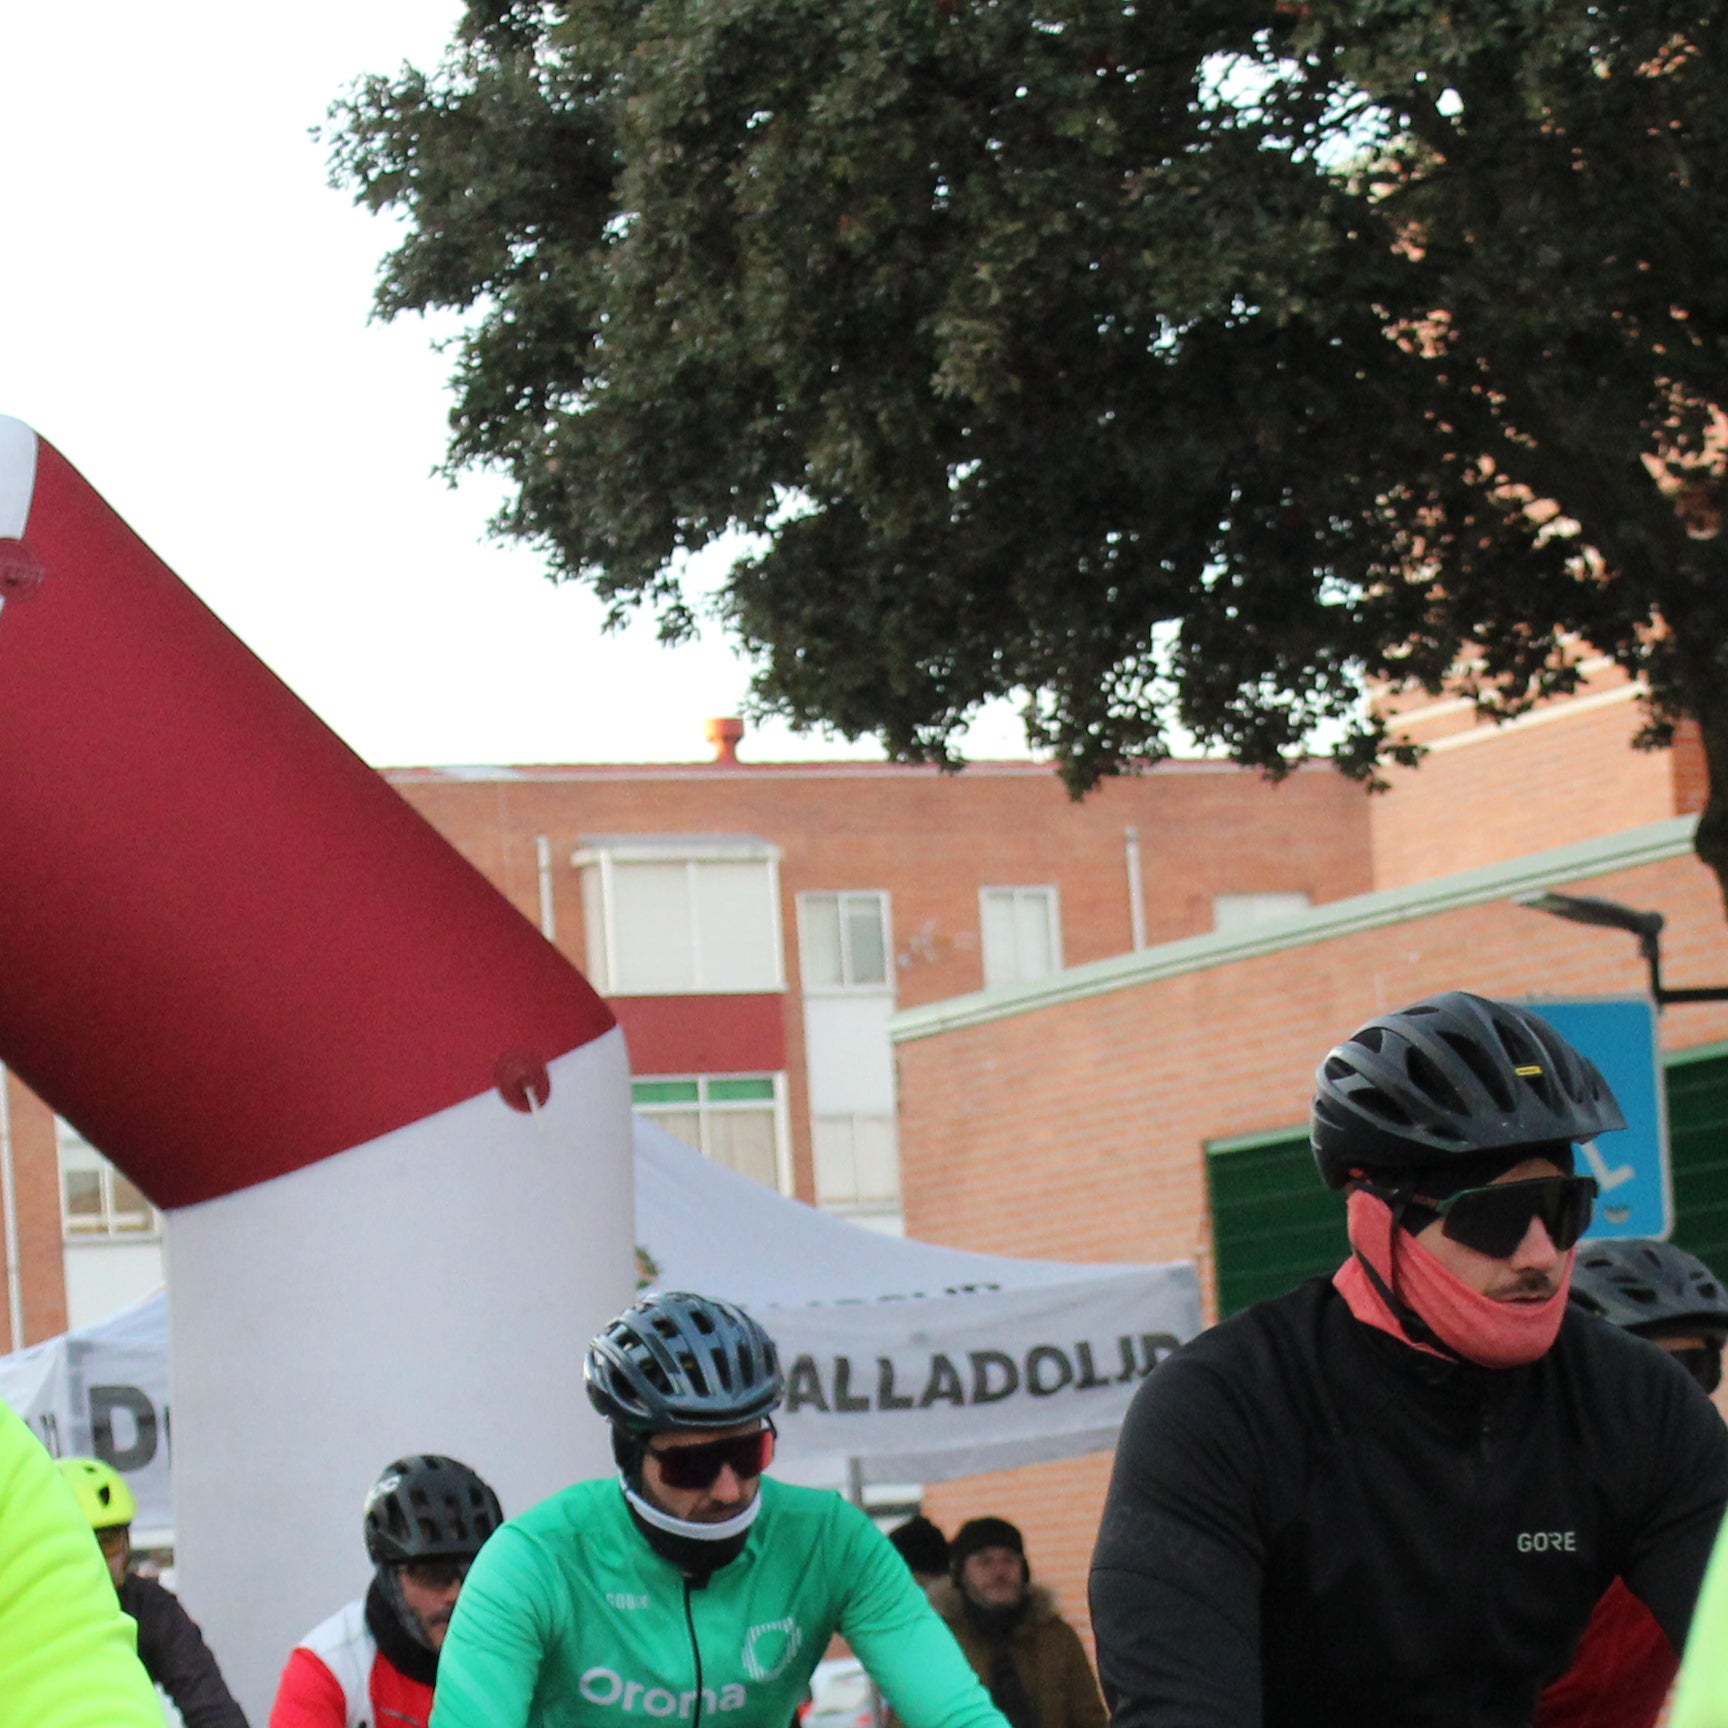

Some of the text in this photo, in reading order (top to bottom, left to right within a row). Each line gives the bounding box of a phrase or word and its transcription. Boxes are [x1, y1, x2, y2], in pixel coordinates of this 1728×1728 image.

[768, 1332, 1181, 1413] ALLADOLID
[1516, 1531, 1576, 1552] GORE
[578, 1666, 747, 1719] Oroma
